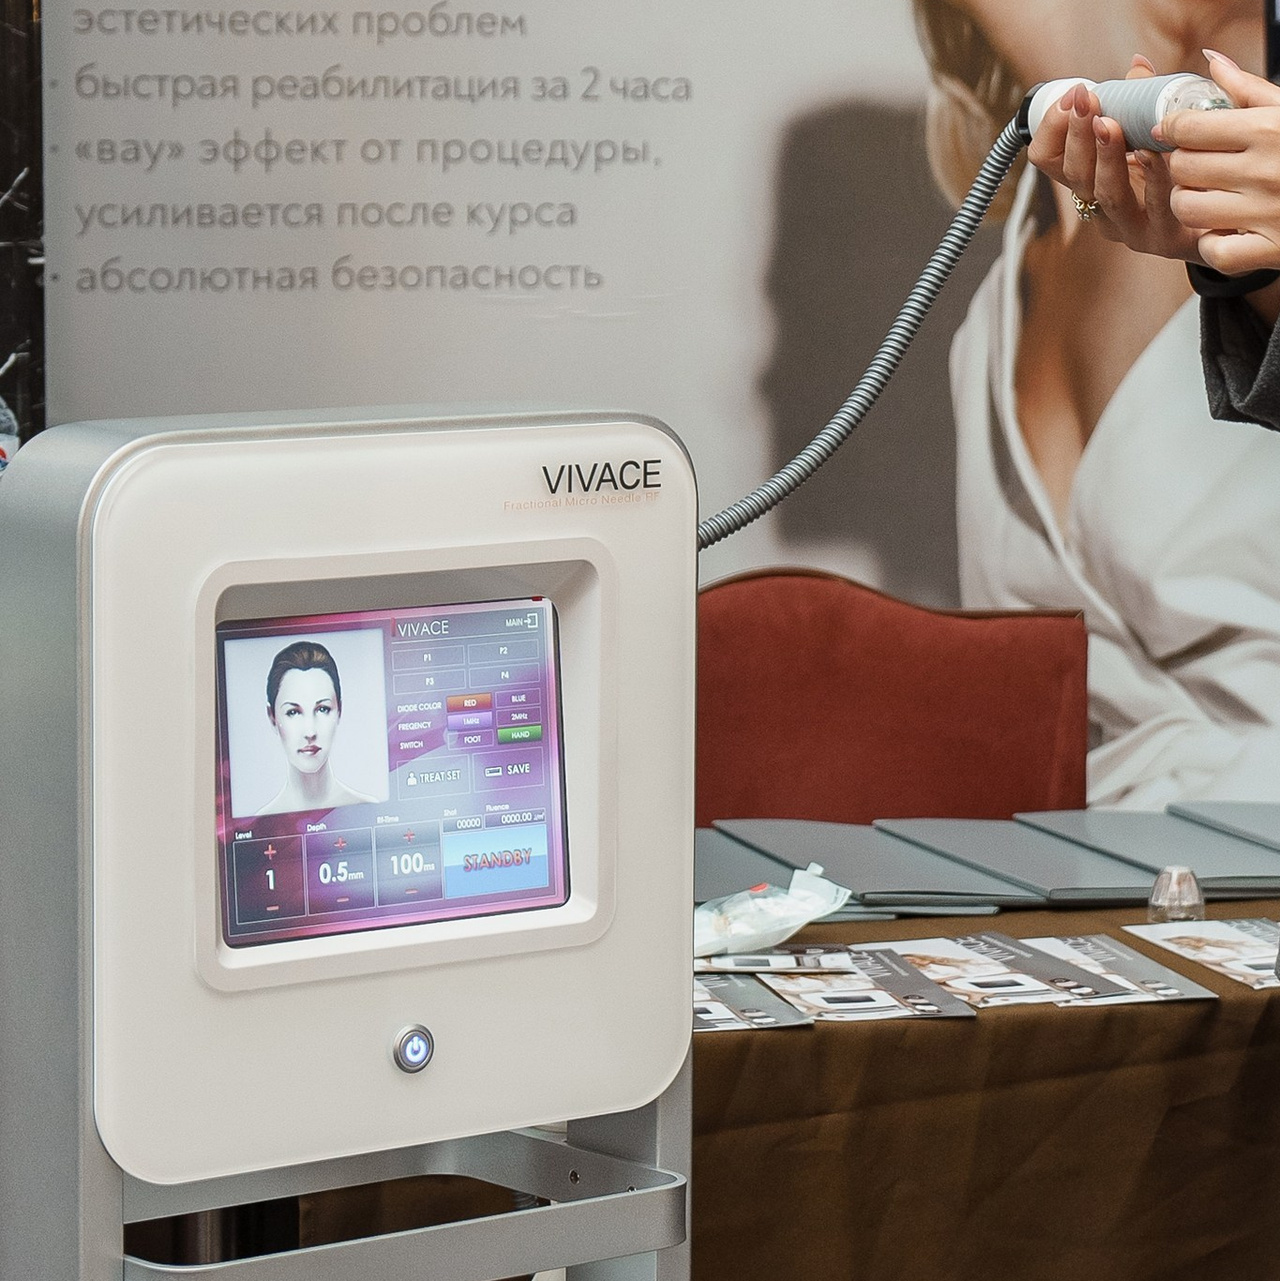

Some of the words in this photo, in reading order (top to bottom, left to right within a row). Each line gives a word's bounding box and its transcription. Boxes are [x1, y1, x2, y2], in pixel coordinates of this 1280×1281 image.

[73, 5, 340, 37] эстетических
[352, 2, 528, 43] проблем
[74, 65, 239, 108] быстрая
[251, 65, 520, 108] реабилитация
[530, 76, 569, 102] за
[579, 66, 602, 102] 2
[609, 75, 693, 103] часа
[74, 138, 184, 171] «вау»
[198, 127, 347, 172] эффект
[360, 140, 402, 163] от
[416, 139, 662, 172] процедуры,
[75, 200, 326, 229] усиливается
[337, 202, 454, 228] после
[466, 198, 578, 234] курса
[75, 259, 319, 293] абсолютная
[331, 254, 603, 292] безопасность
[542, 459, 662, 494] VIVACE
[503, 498, 562, 511] Fractional
[565, 495, 597, 507] Micro
[601, 492, 642, 505] Needle
[645, 491, 660, 502] RF
[397, 620, 449, 637] VIVACE
[505, 618, 523, 627] MAIN
[423, 653, 432, 661] P1
[500, 647, 508, 655] P2
[501, 671, 509, 679] P4
[397, 704, 418, 713] DIODE
[418, 701, 442, 711] COLOR
[464, 699, 477, 707] RED
[400, 740, 424, 750] SWITCH
[464, 735, 481, 743] FOOT
[511, 730, 530, 739] HAND
[420, 772, 446, 784] TREAT
[447, 770, 461, 781] SET
[507, 763, 530, 775] SAVE
[235, 830, 253, 840] Level
[307, 822, 327, 832] Depth
[463, 848, 532, 872] STANDBY
[265, 869, 276, 890] 1
